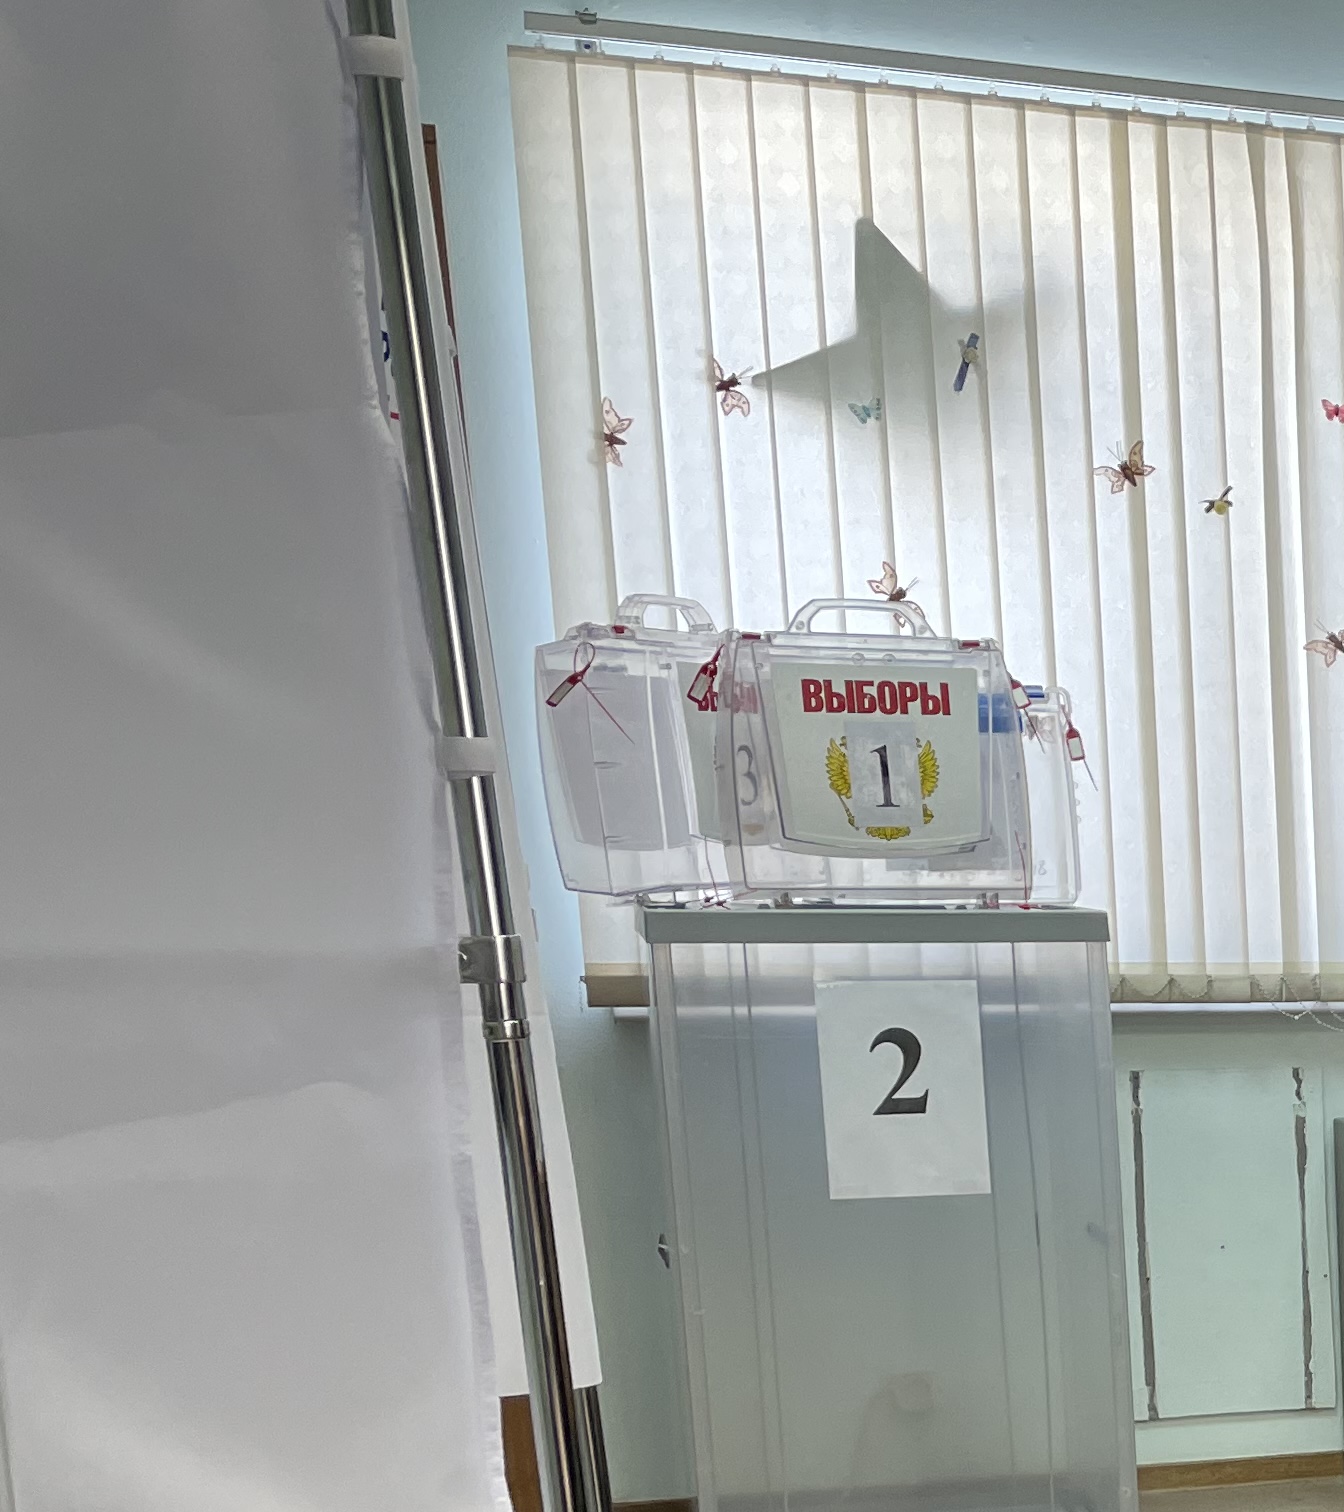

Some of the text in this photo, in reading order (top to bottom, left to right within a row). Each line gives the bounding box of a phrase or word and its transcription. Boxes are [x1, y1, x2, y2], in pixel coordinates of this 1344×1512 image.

[801, 678, 952, 716] ВЫБОРЫ
[869, 745, 901, 808] 1
[869, 1026, 930, 1116] 2
